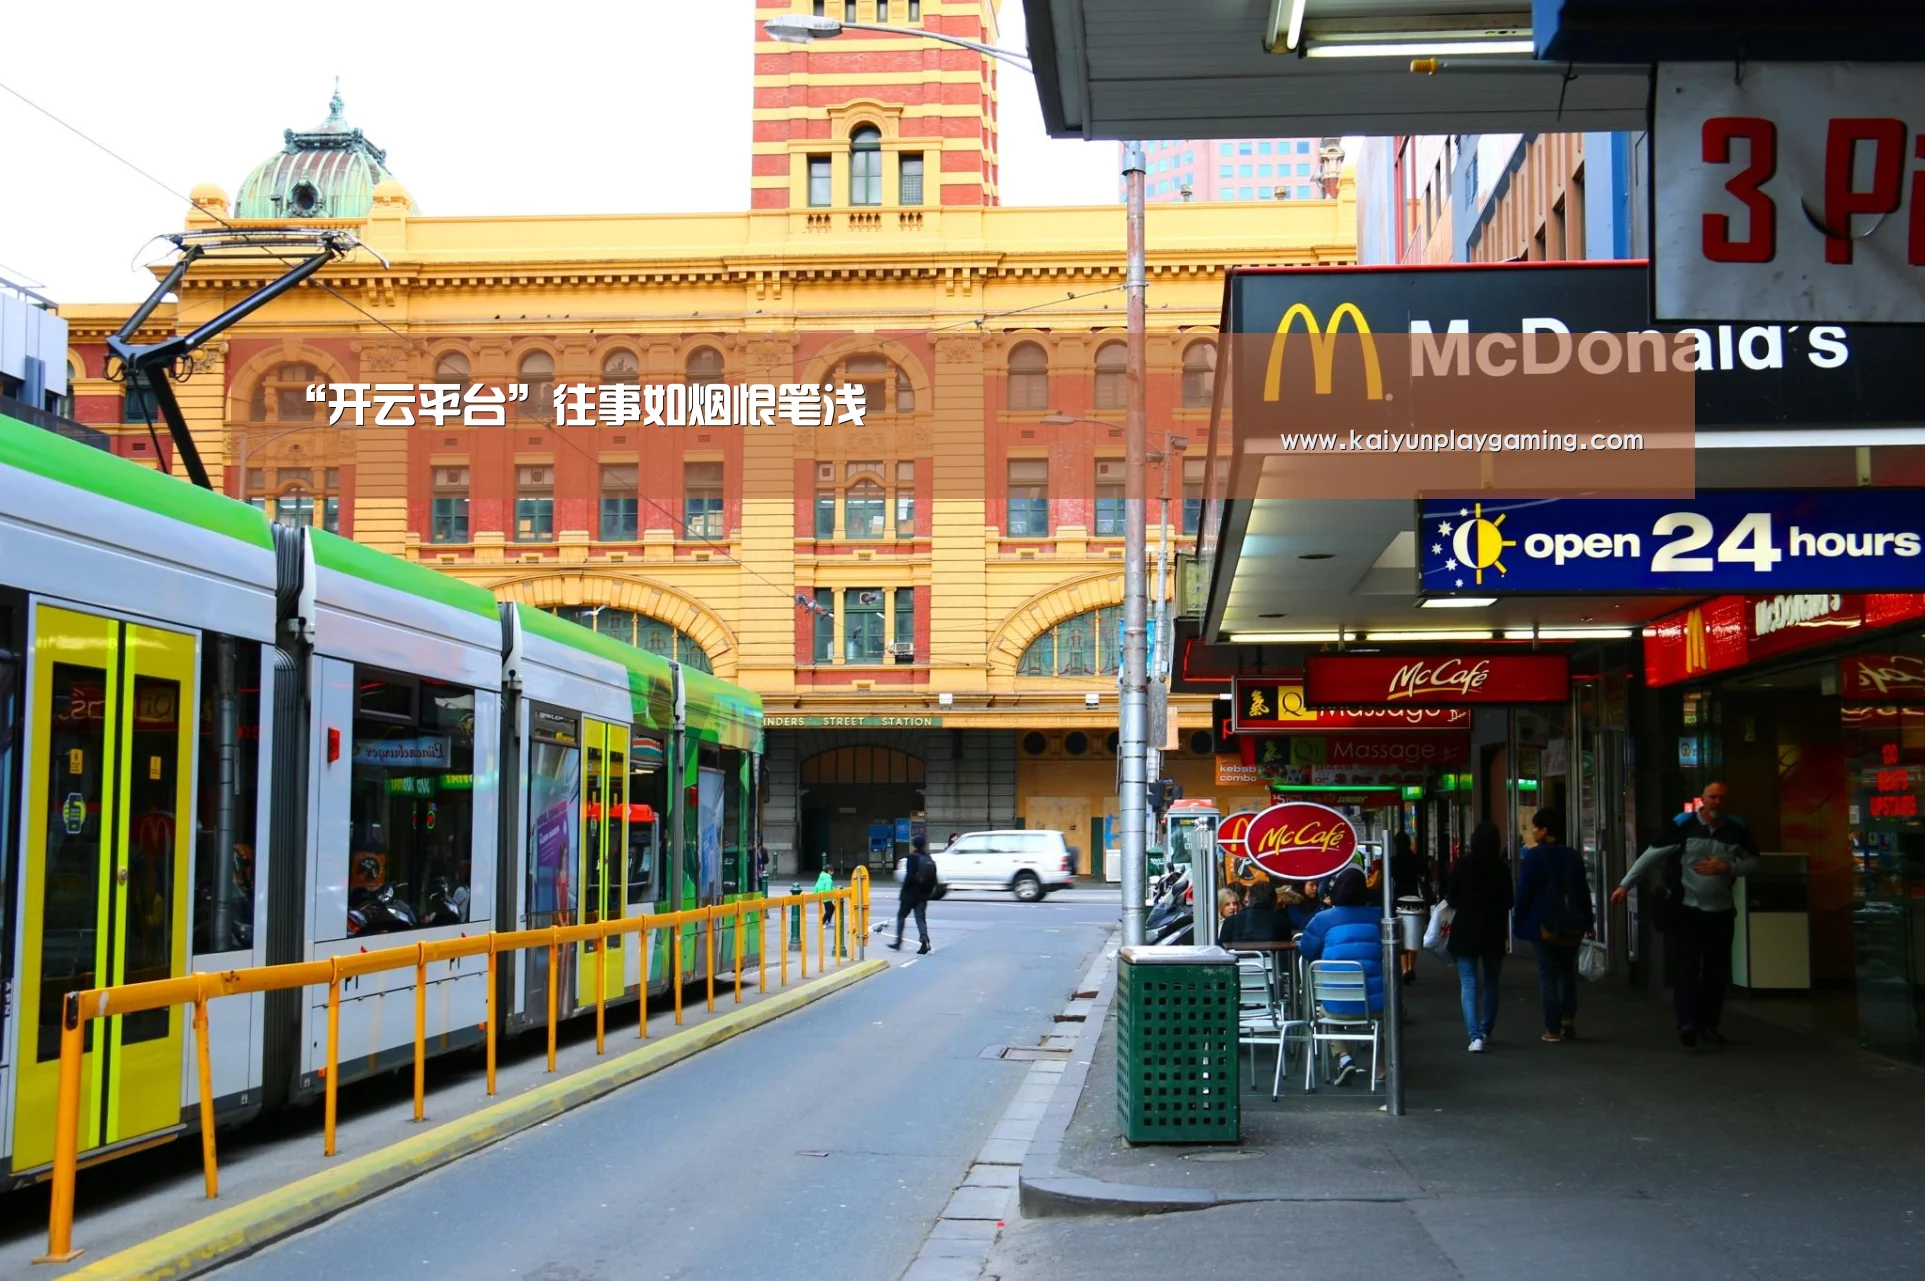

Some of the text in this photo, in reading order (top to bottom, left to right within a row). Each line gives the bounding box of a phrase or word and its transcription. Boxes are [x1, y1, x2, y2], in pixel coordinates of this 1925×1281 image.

[1702, 117, 1777, 264] 3
[1525, 511, 1922, 572] open 24 hours
[1388, 658, 1490, 697] McCafé
[1282, 691, 1303, 717] Q
[763, 717, 932, 726] INDERS STREET STATION
[1333, 741, 1436, 763] Massage
[1220, 764, 1257, 773] kebab
[1220, 774, 1257, 782] combo
[1257, 821, 1345, 856] McCafé
